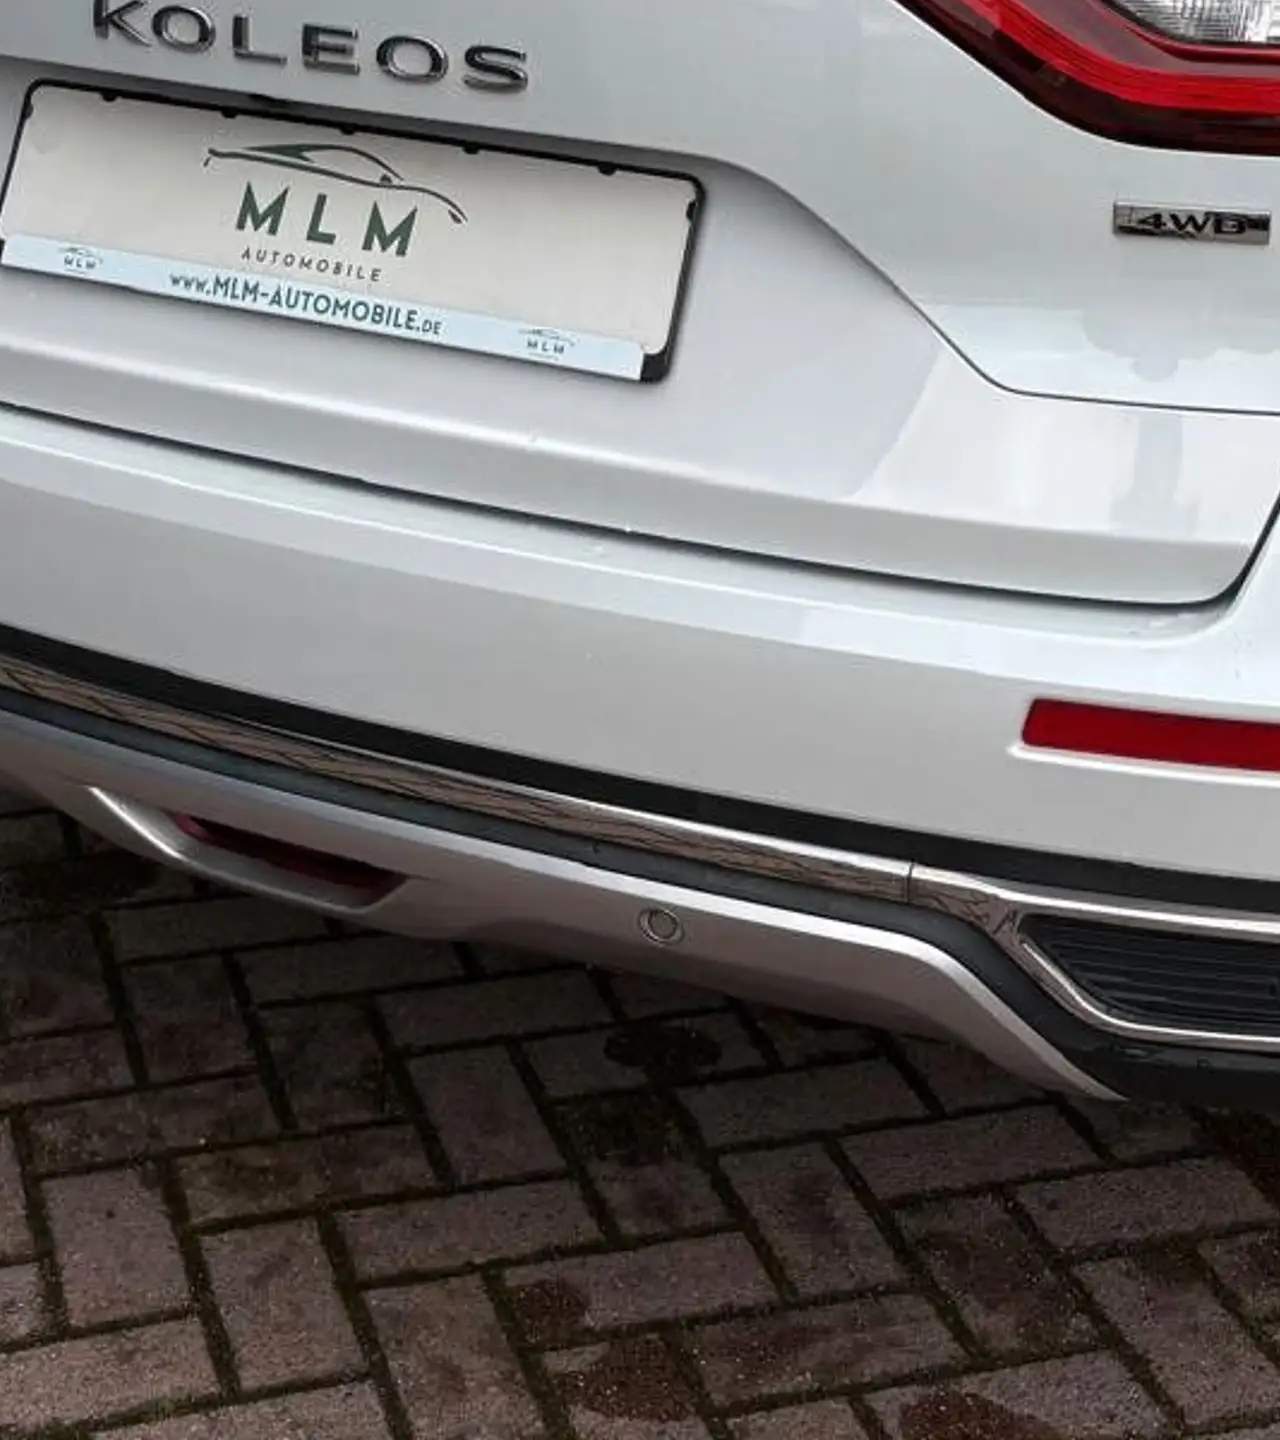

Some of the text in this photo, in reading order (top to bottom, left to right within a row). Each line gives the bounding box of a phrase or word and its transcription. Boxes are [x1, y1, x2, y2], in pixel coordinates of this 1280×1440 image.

[235, 180, 419, 258] MLM
[1132, 209, 1250, 237] 4WD
[241, 245, 383, 283] AUTOMOBILE
